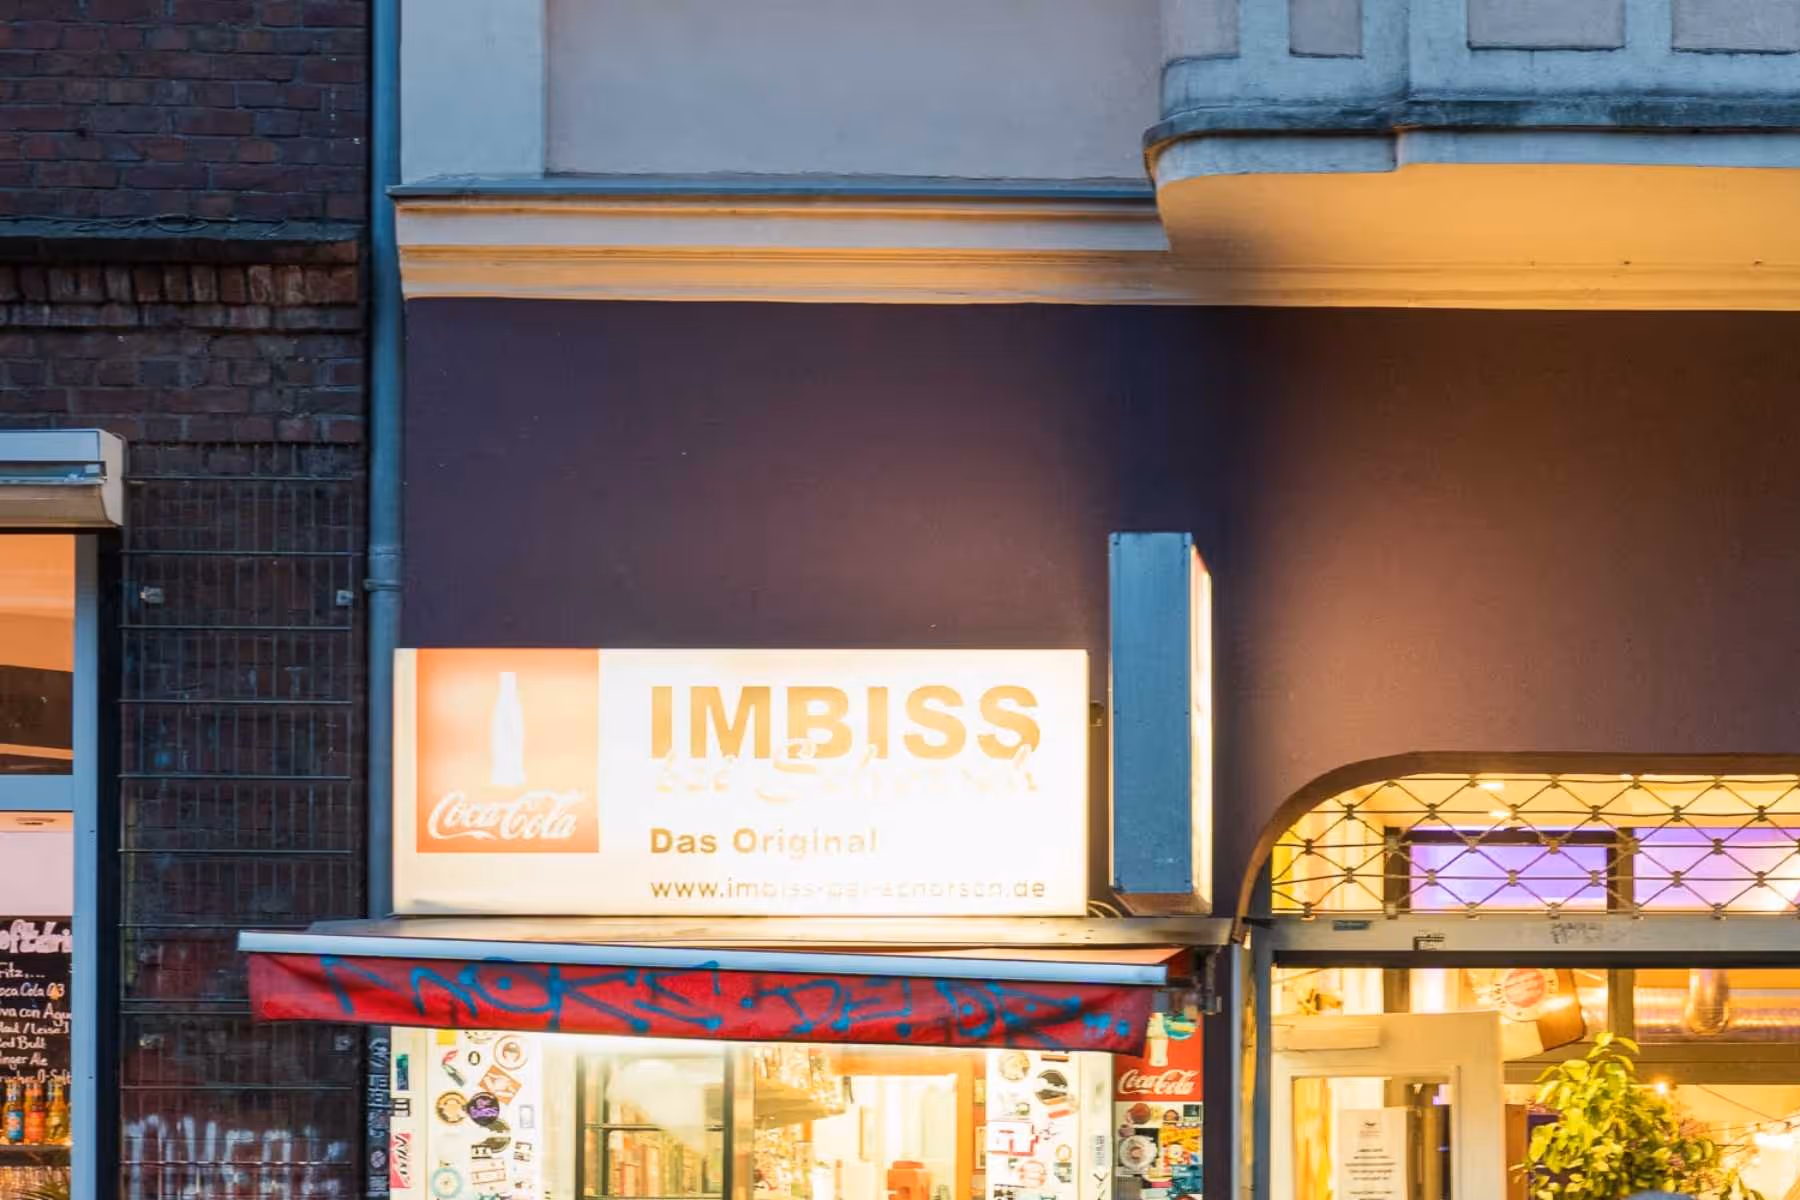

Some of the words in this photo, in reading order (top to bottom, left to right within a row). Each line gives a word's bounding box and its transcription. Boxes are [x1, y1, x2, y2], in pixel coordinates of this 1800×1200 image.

[651, 685, 1041, 761] IMBISS
[427, 789, 584, 840] Coca-Cola
[651, 828, 717, 854] Das
[733, 828, 879, 860] Original
[1118, 1069, 1199, 1095] Coca-Cola
